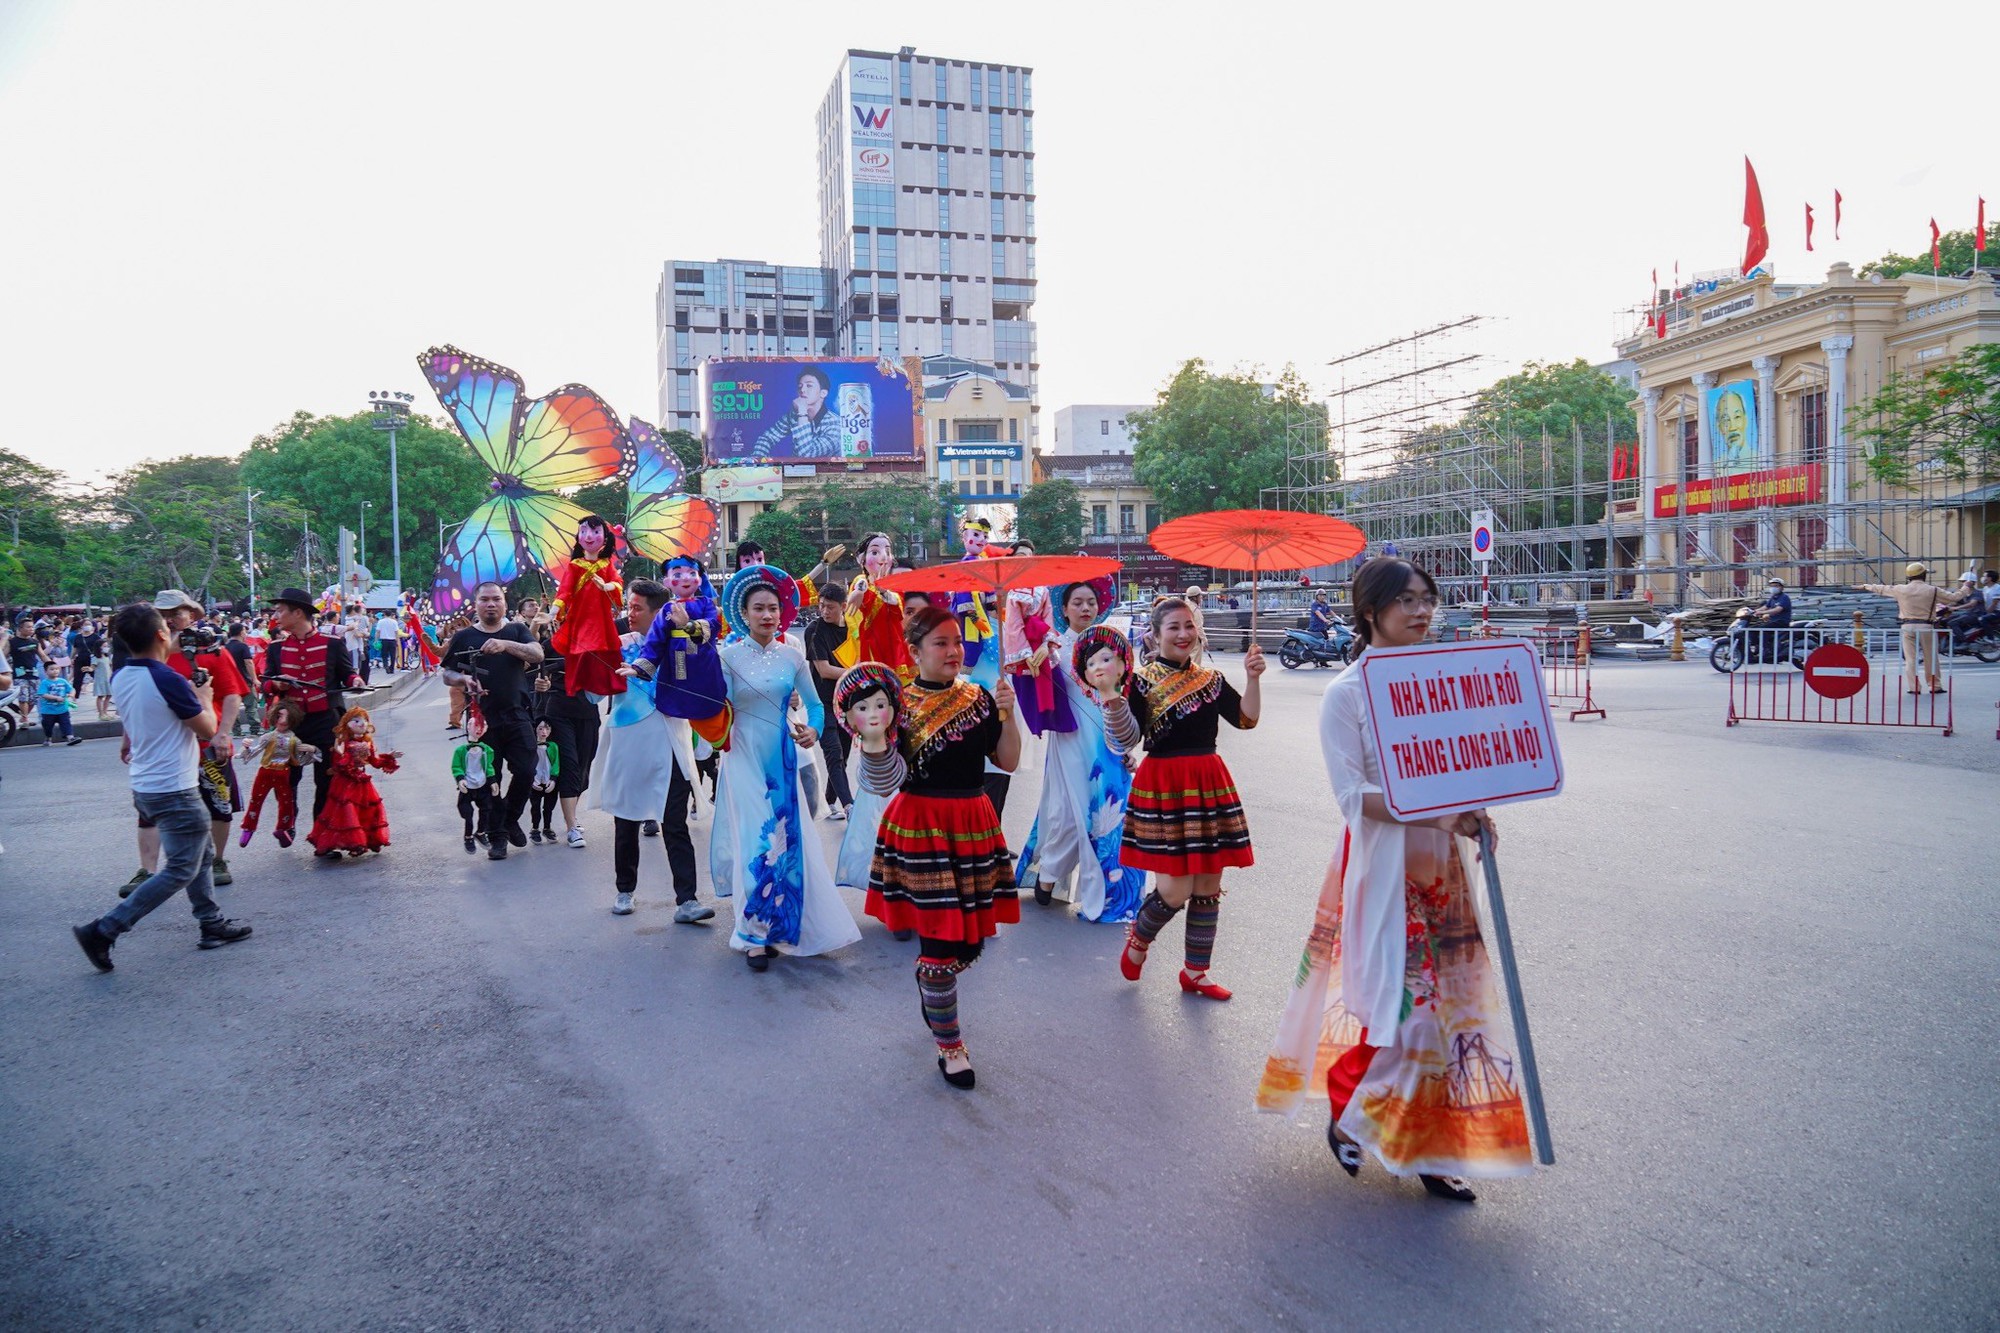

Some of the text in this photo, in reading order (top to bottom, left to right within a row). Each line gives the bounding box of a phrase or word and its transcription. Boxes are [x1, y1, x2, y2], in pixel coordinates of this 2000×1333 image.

[712, 393, 763, 412] SOJU
[737, 381, 762, 393] Tiger
[1389, 659, 1522, 717] NHÀ HÁT MÚA RỐI
[1392, 720, 1543, 780] THĂNG LONG HÀ NỘI
